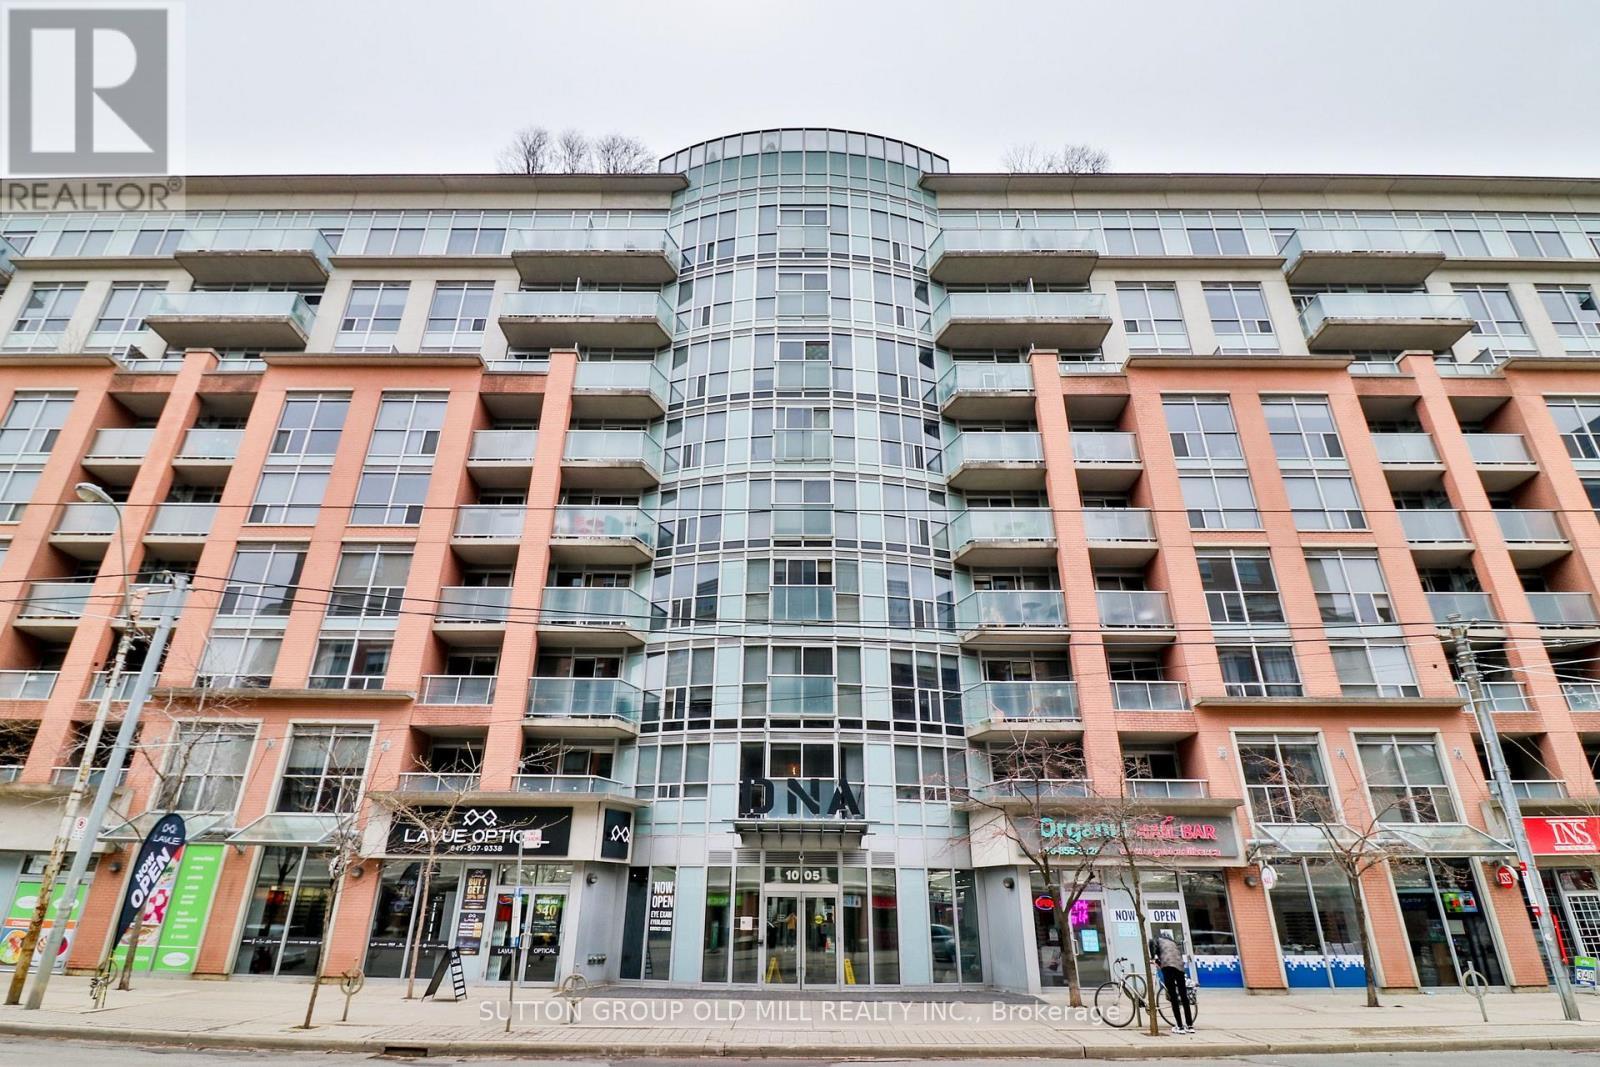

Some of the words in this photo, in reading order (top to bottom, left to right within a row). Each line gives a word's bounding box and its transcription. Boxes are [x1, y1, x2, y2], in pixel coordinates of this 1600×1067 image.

[739, 778, 860, 815] DNA
[403, 828, 468, 843] LAVUE
[1040, 817, 1129, 843] Organi
[1180, 824, 1217, 840] BAR
[1548, 822, 1592, 845] INS
[135, 851, 155, 883] NOW
[130, 846, 171, 909] OPEN
[467, 885, 482, 895] GET
[482, 885, 487, 895] 1
[654, 881, 674, 894] NOW
[652, 895, 674, 908] OPEN
[1115, 910, 1135, 921] NOW
[1153, 910, 1177, 921] OPEN
